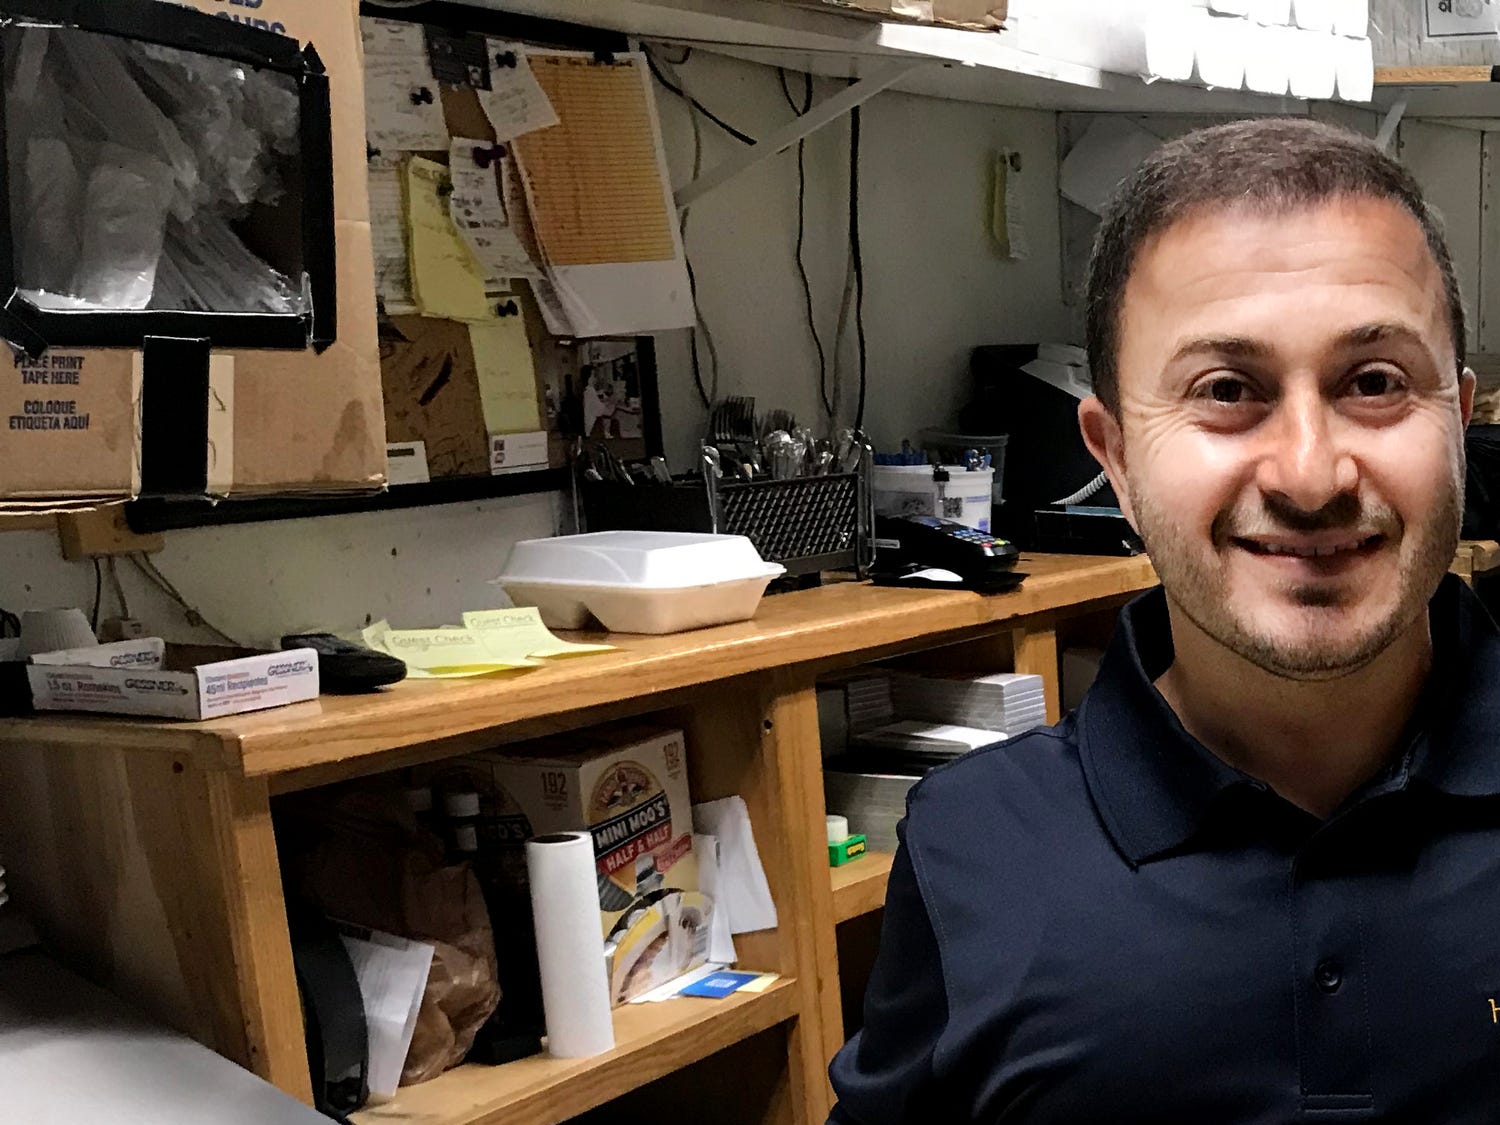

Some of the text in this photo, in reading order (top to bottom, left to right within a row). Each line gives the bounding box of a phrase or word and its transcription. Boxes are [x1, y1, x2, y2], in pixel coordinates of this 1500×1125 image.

[51, 355, 85, 370] PRINT
[21, 370, 79, 385] TAPE HERE
[24, 400, 76, 415] COLOQUE
[9, 415, 60, 430] ETIQUETA
[540, 771, 568, 795] 192
[595, 800, 667, 849] MINI MOO'S
[605, 844, 635, 872] HALF
[645, 825, 670, 847] HALF
